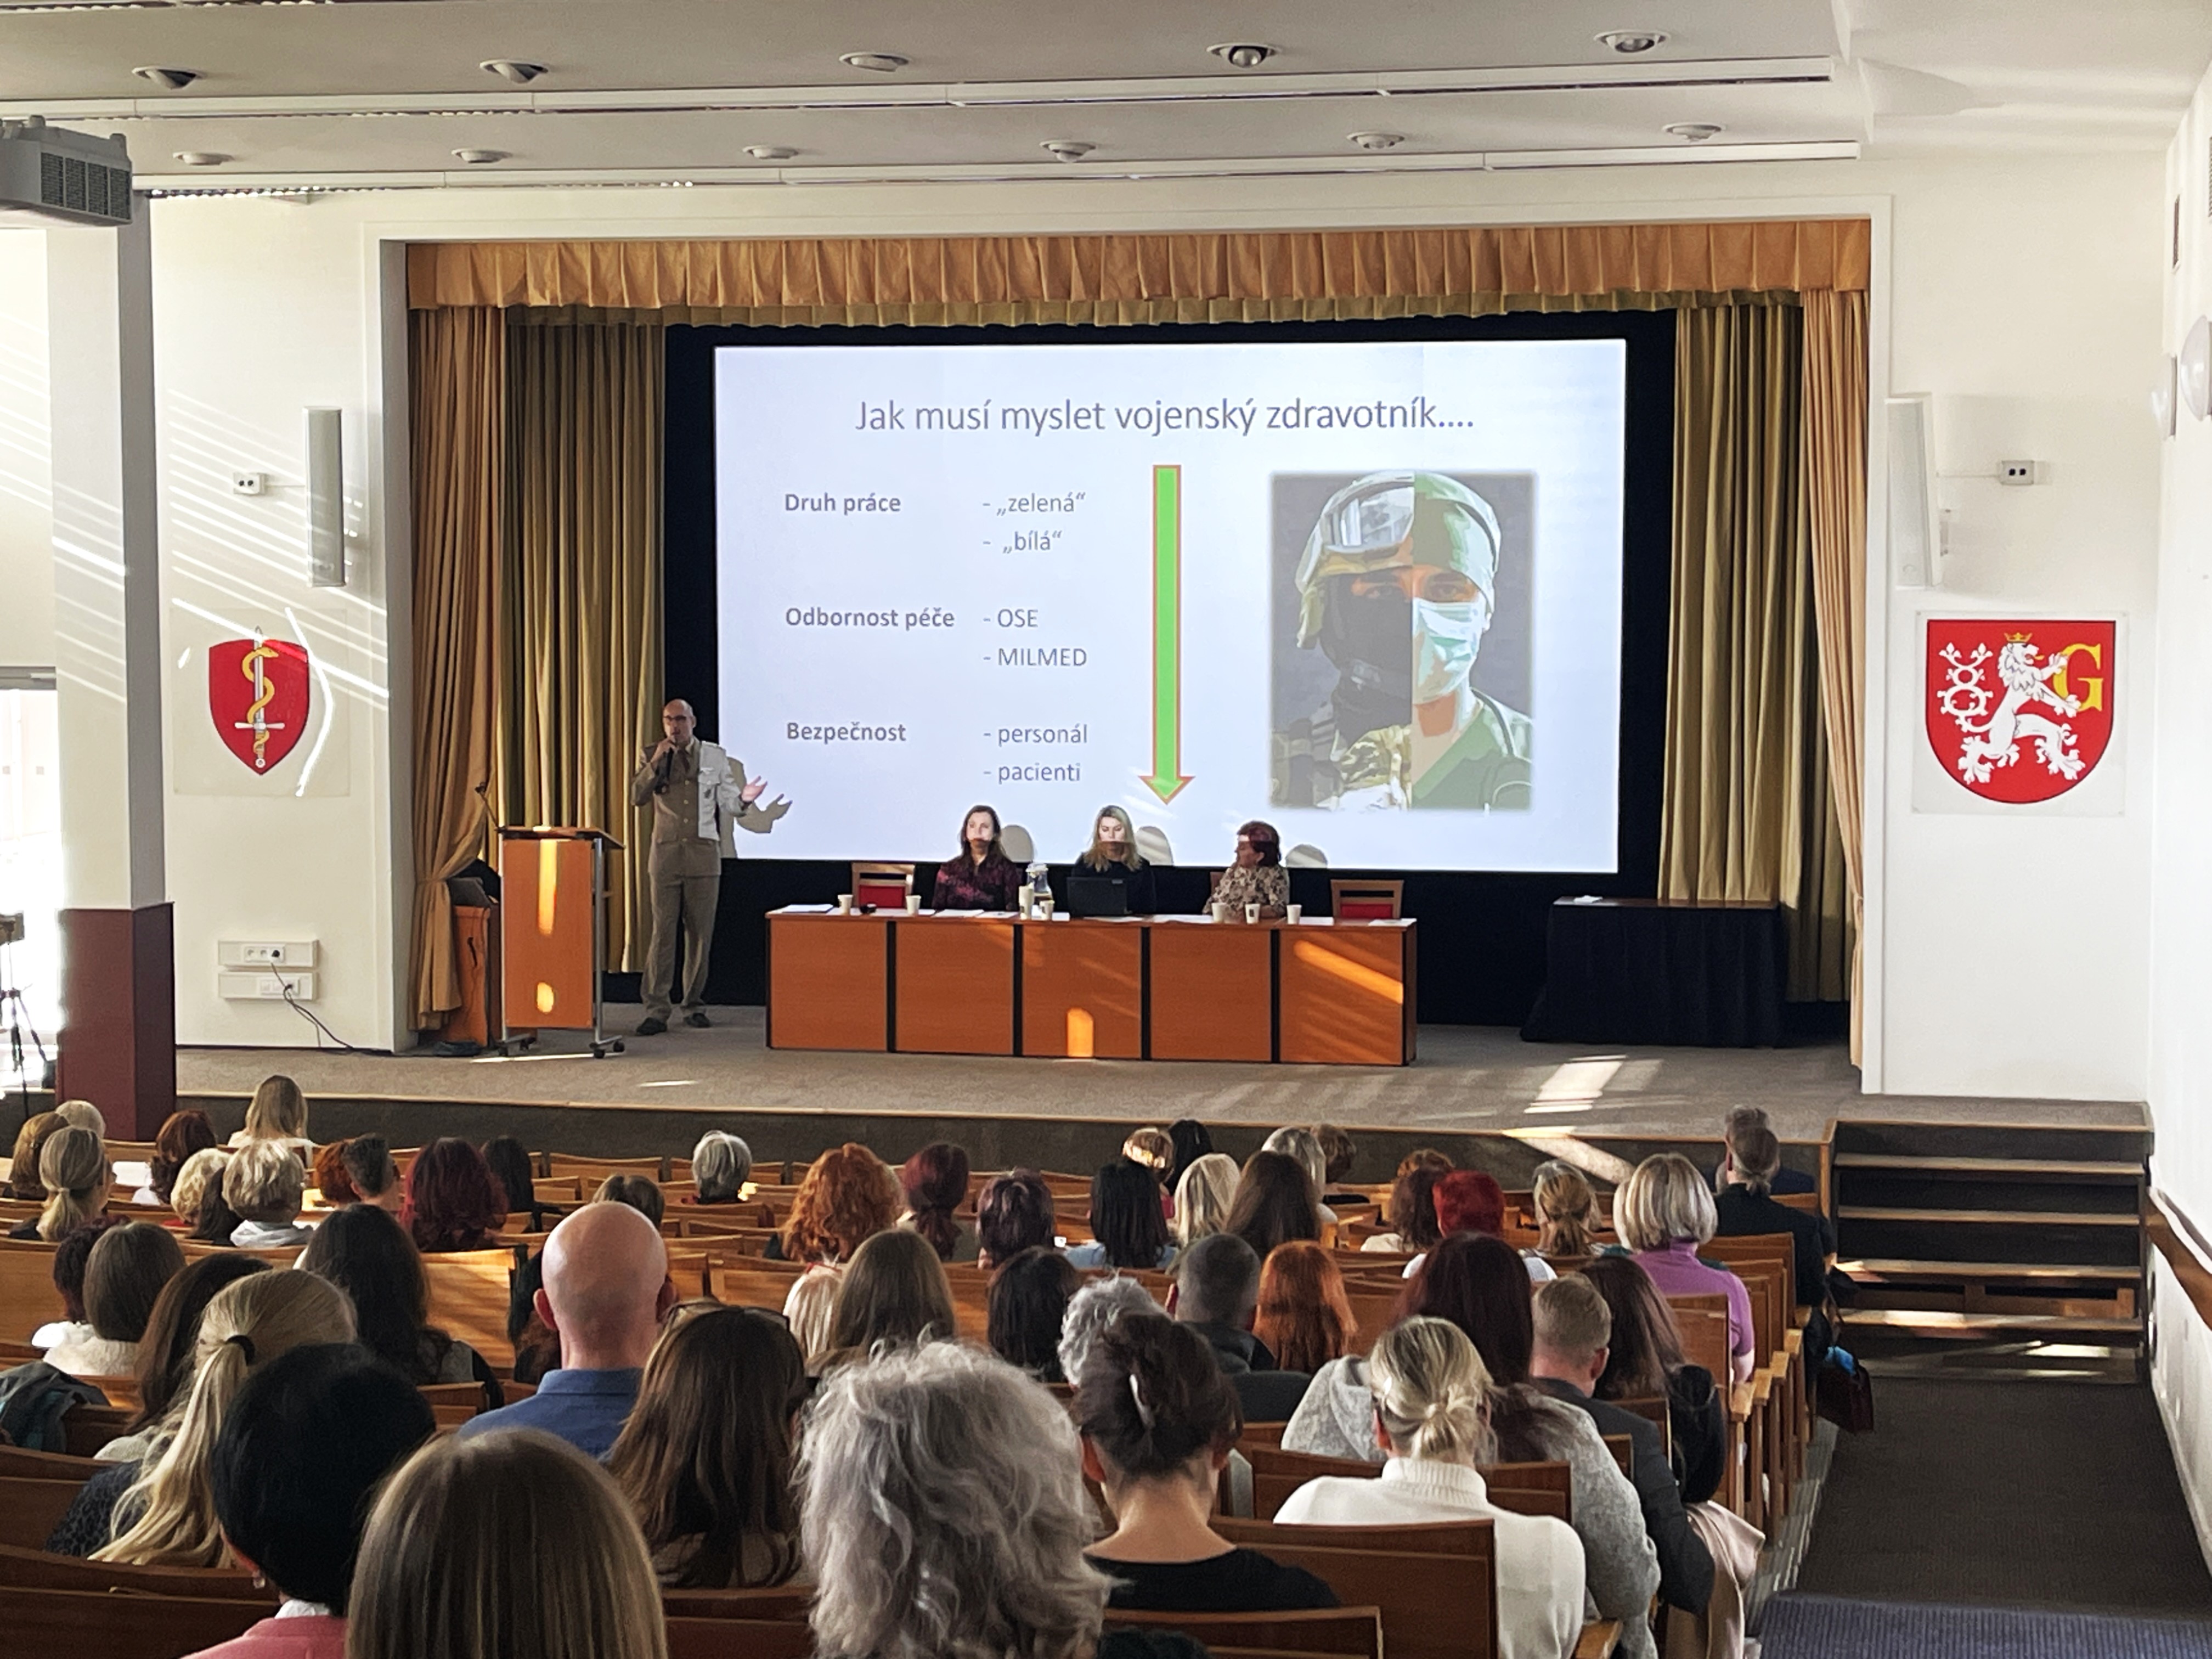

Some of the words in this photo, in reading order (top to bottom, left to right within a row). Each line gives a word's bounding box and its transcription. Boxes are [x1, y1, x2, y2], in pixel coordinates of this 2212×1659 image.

[855, 399, 905, 431] Jak
[916, 399, 992, 430] musí
[1001, 398, 1106, 437] myslet
[1114, 397, 1257, 437] vojenský
[1266, 396, 1474, 429] zdravotník....
[785, 492, 836, 512] Druh
[843, 492, 901, 516] práce
[996, 492, 1086, 516] „zelená“
[1003, 530, 1063, 554] „bílá“
[785, 606, 900, 628] Odbornost
[905, 607, 956, 632] péče
[997, 608, 1039, 629] OSE
[997, 647, 1088, 667] MILMED
[2052, 643, 2103, 713] G
[786, 721, 907, 746] Bezpečnost
[997, 723, 1088, 748] personál
[998, 762, 1081, 785] pacienti
